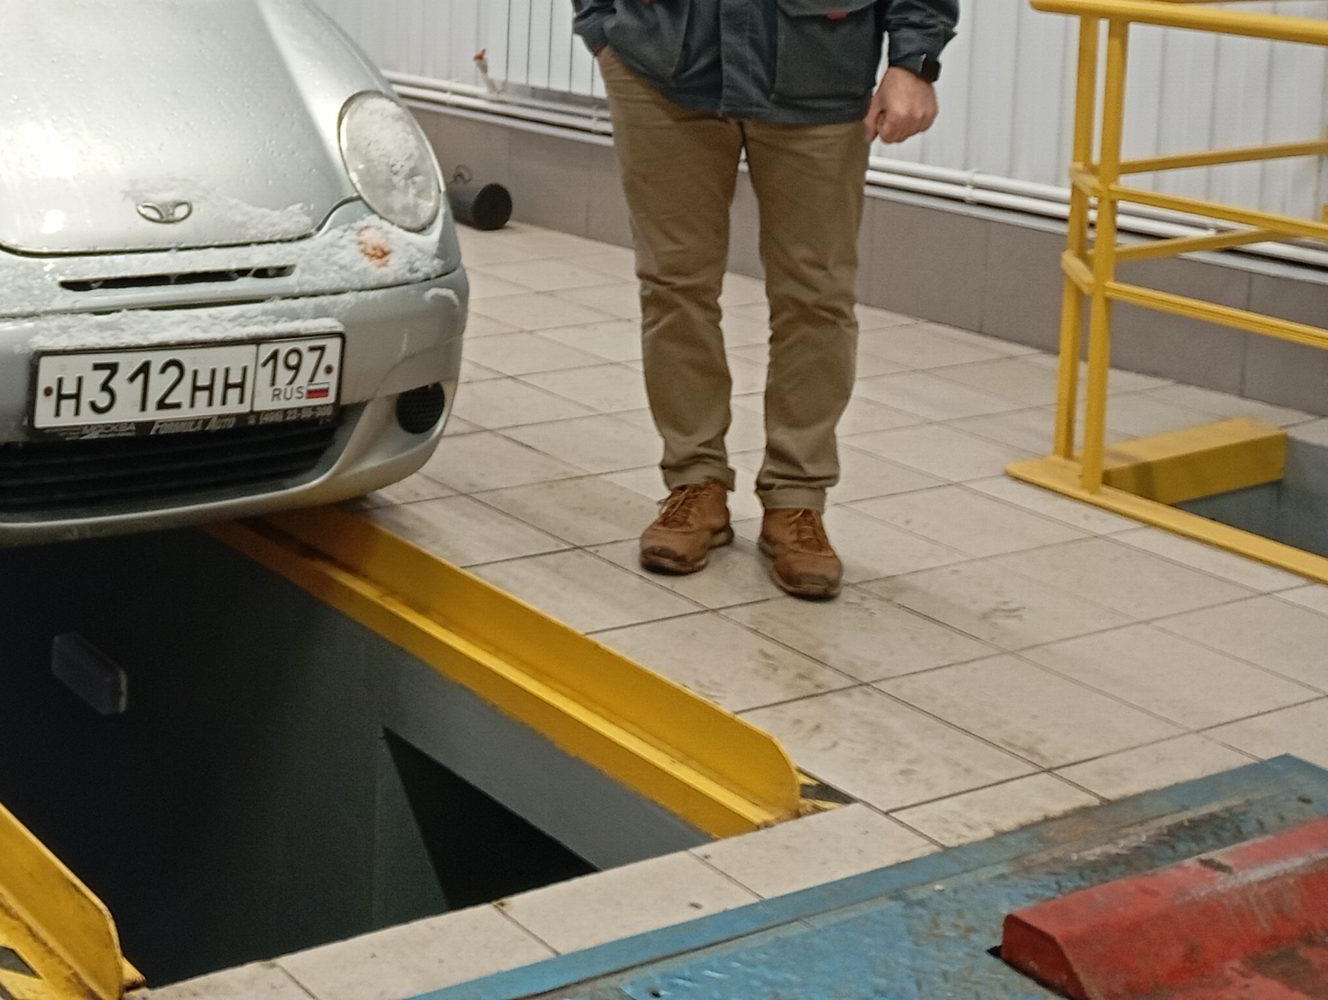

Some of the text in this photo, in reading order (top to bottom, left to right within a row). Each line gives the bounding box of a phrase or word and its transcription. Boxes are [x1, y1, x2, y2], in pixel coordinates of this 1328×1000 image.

[53, 358, 248, 418] Н312НН
[260, 344, 327, 387] 197
[272, 386, 304, 402] RUS
